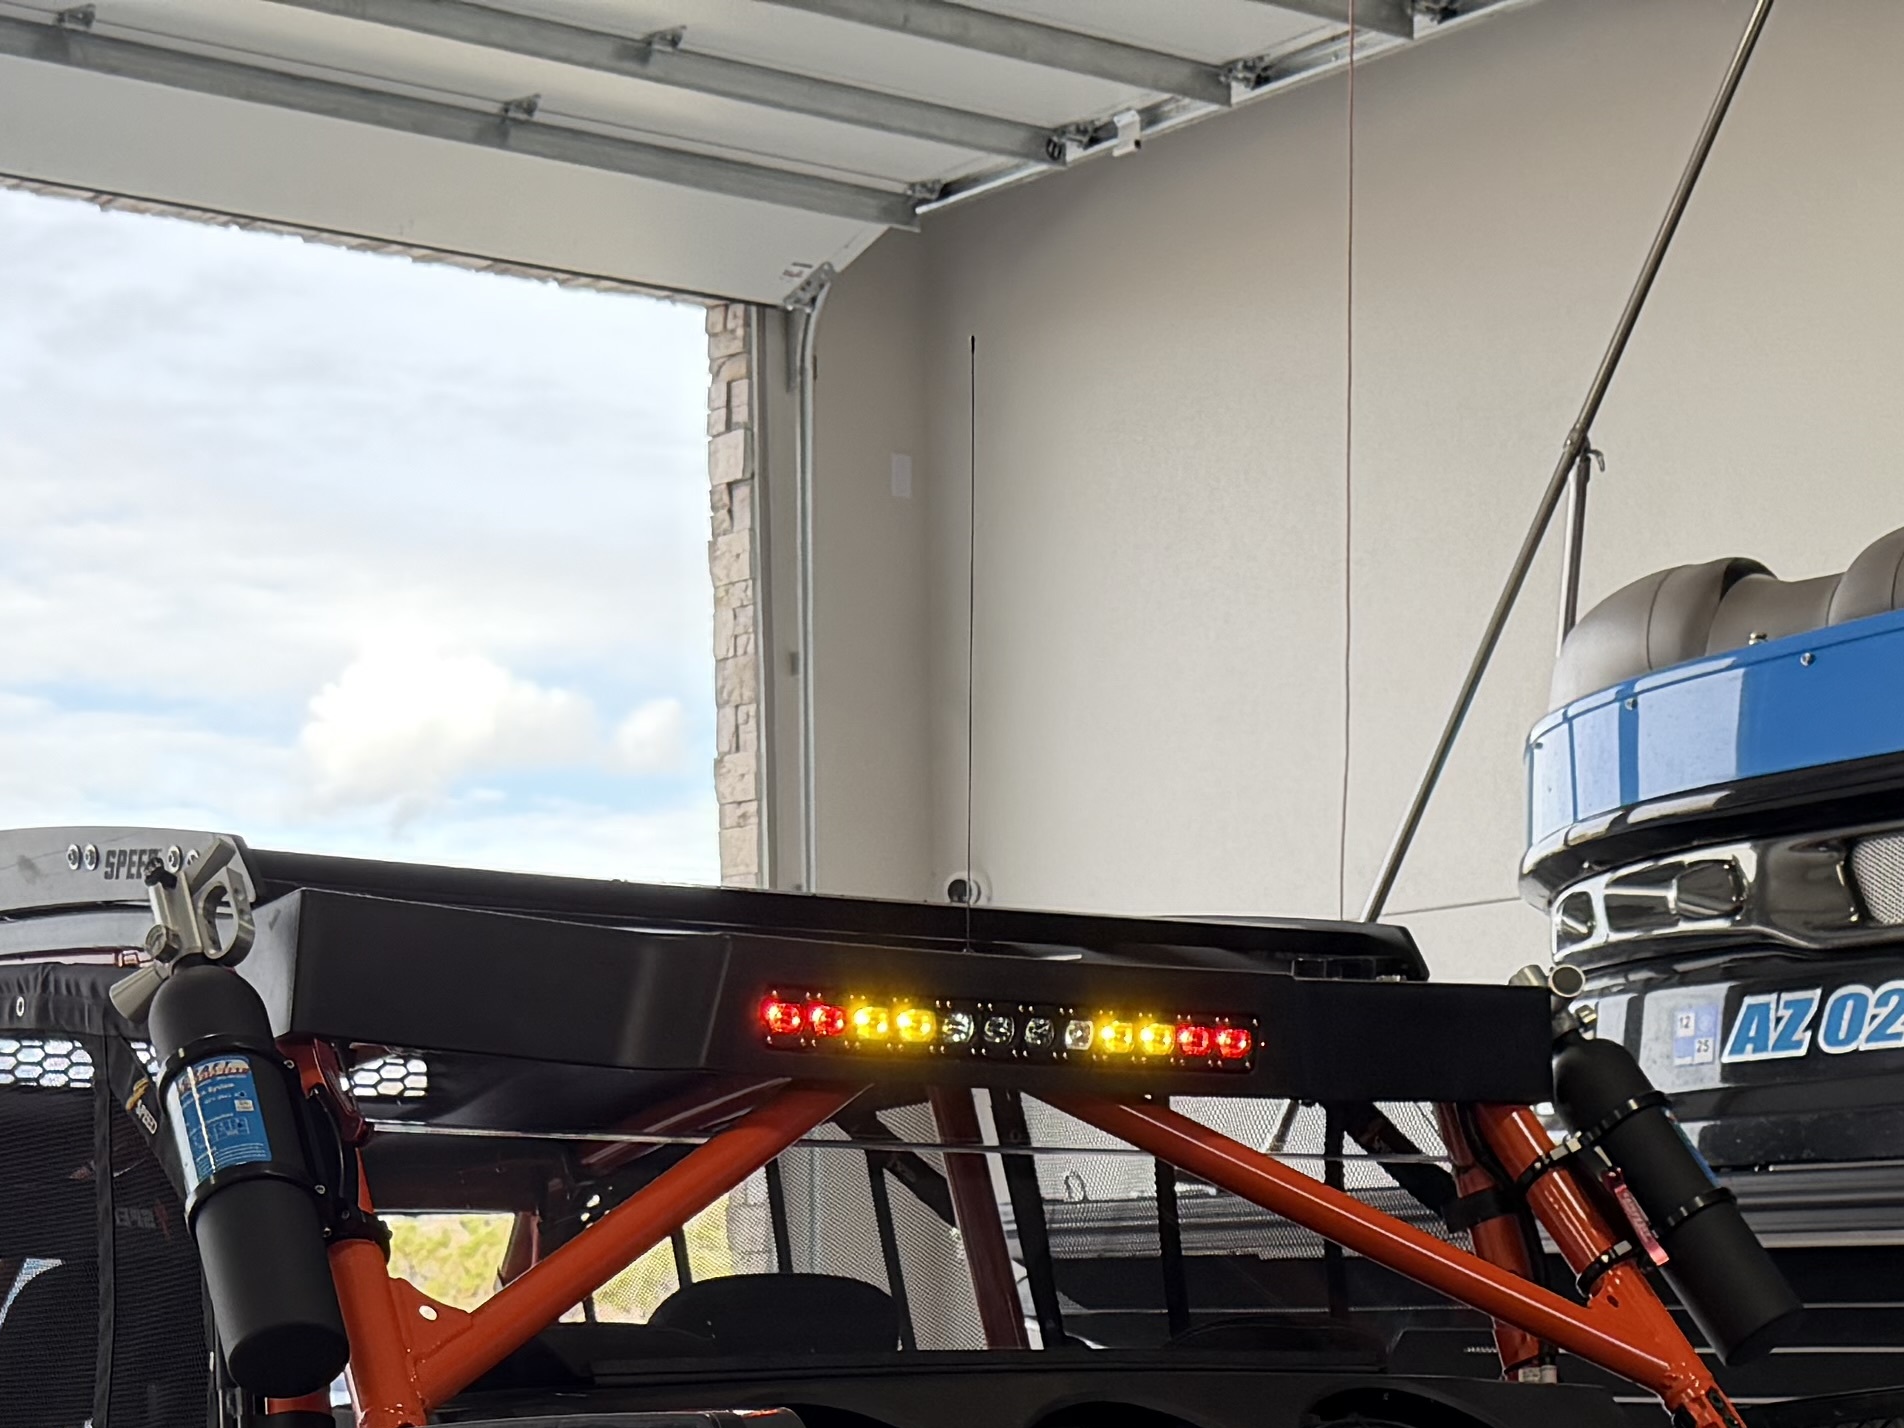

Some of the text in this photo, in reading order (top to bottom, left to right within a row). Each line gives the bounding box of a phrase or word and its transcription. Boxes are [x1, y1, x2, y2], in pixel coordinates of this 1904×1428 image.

[1678, 1015, 1691, 1028] 12
[1722, 988, 1821, 1063] AZ
[1696, 1039, 1710, 1053] 25
